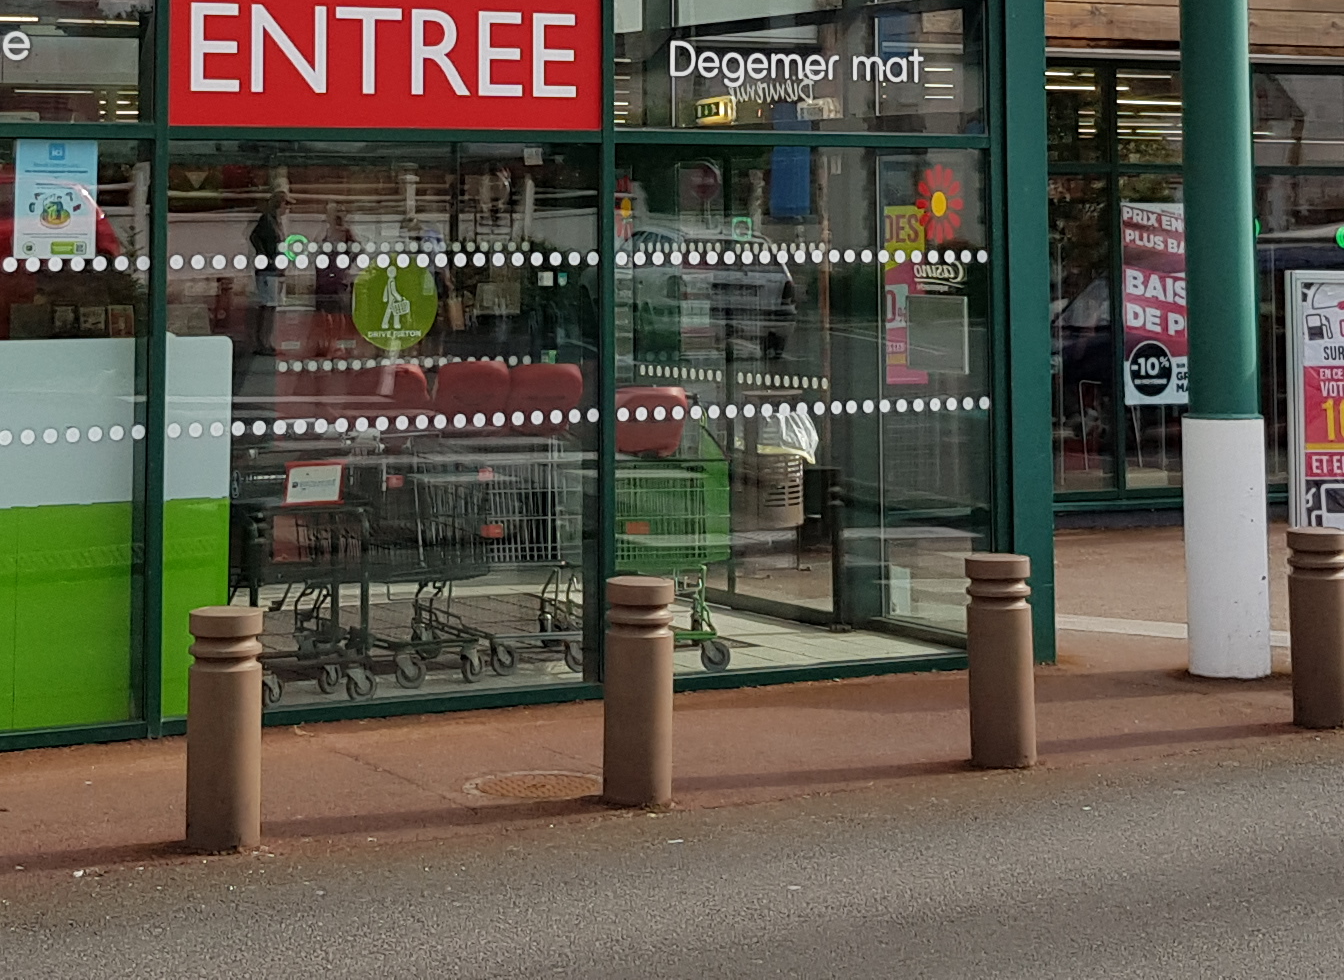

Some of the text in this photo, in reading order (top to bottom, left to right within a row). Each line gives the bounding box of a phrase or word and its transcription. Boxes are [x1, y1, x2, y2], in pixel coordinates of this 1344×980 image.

[191, 2, 576, 98] ENTREE
[670, 40, 924, 87] Degemer mat
[1122, 206, 1158, 227] PRIX
[1124, 229, 1165, 250] PLUS
[1126, 302, 1162, 333] DE
[1323, 345, 1344, 361] SUR
[1130, 356, 1170, 376] -10%
[1319, 369, 1331, 379] EN
[1333, 369, 1343, 379] CE
[1311, 456, 1329, 474] ET
